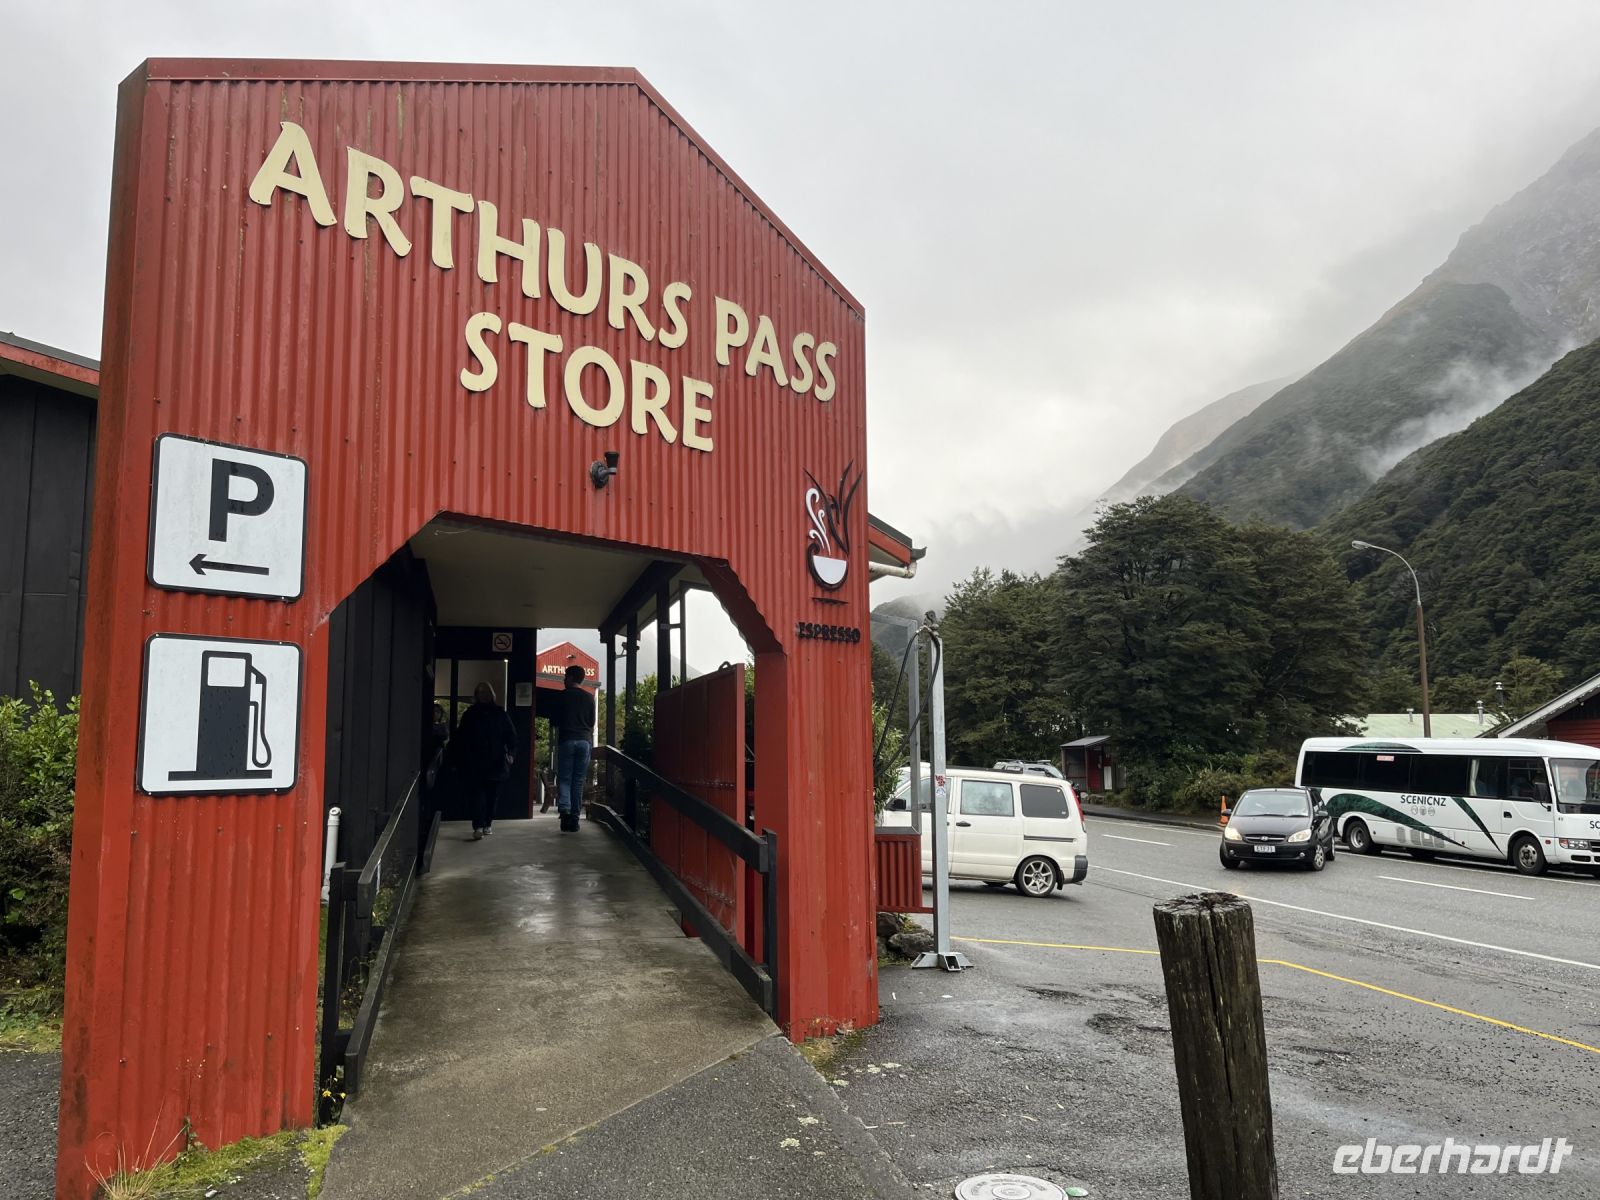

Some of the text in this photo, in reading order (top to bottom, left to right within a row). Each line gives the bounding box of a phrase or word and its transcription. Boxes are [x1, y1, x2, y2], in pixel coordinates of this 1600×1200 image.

[248, 120, 837, 403] ARTHURS PASS
[459, 311, 715, 452] STORE
[208, 457, 275, 543] P
[797, 621, 861, 643] ESPRESSO
[542, 664, 567, 675] ARTHU
[1400, 794, 1447, 807] SCENICNZ
